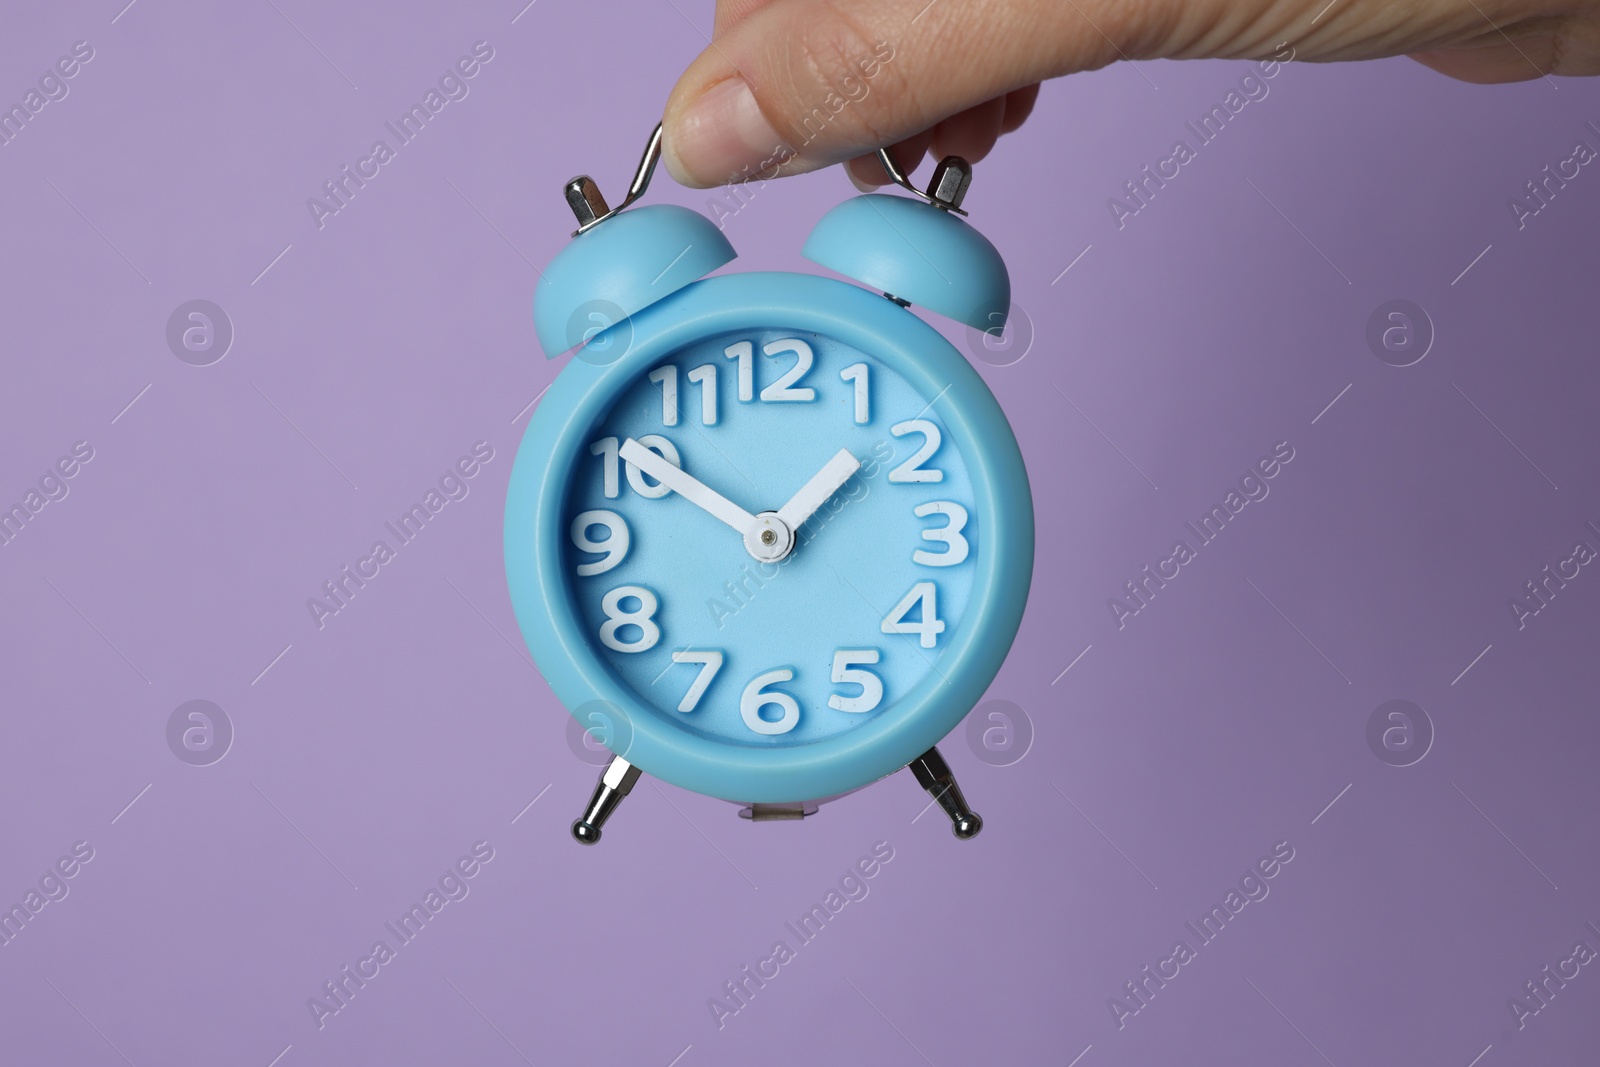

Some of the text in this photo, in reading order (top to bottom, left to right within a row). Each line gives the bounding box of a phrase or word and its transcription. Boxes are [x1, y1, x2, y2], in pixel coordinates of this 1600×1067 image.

[648, 364, 718, 426] 11
[724, 338, 816, 402] 12
[840, 363, 870, 424] 1
[590, 435, 680, 498] 10
[888, 420, 943, 483] 2
[570, 510, 630, 577] 9
[913, 501, 969, 567] 3
[600, 586, 660, 653] 8
[881, 582, 945, 648] 4
[671, 651, 723, 713] 7
[740, 669, 800, 735] 6
[827, 650, 884, 713] 5
